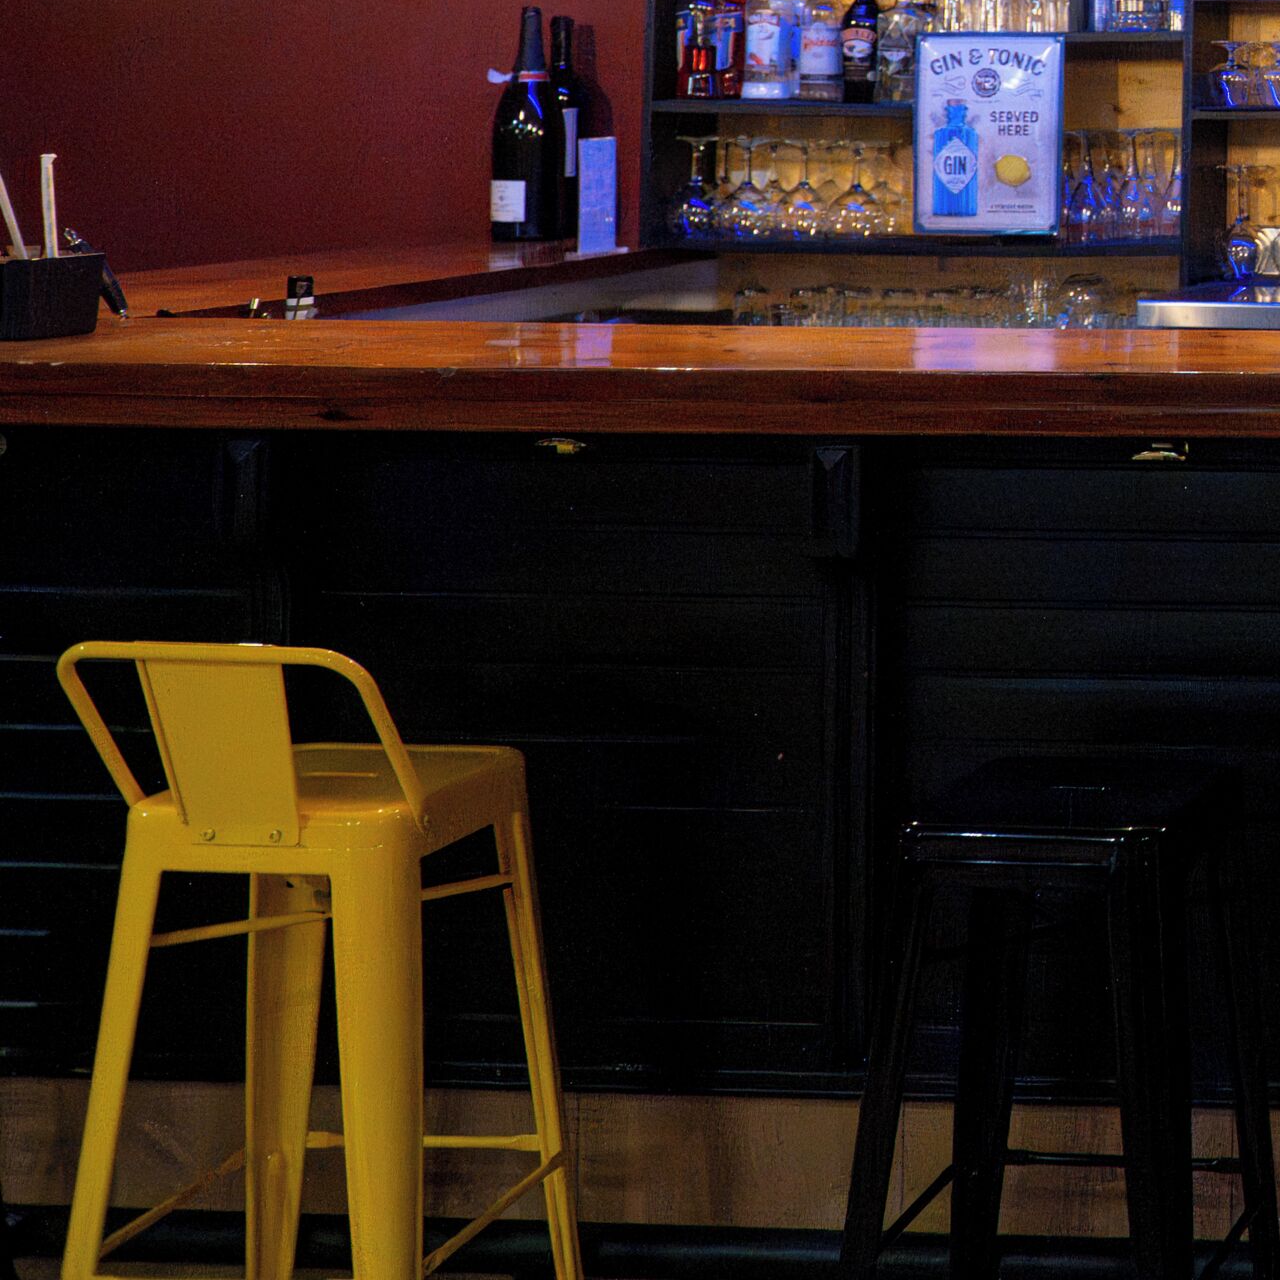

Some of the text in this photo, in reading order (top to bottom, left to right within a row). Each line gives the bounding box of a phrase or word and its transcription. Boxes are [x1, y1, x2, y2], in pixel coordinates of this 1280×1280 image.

[930, 48, 1048, 77] GIN & TONIC
[989, 110, 1039, 124] SERVED
[997, 124, 1031, 137] HERE
[943, 155, 968, 176] GIN
